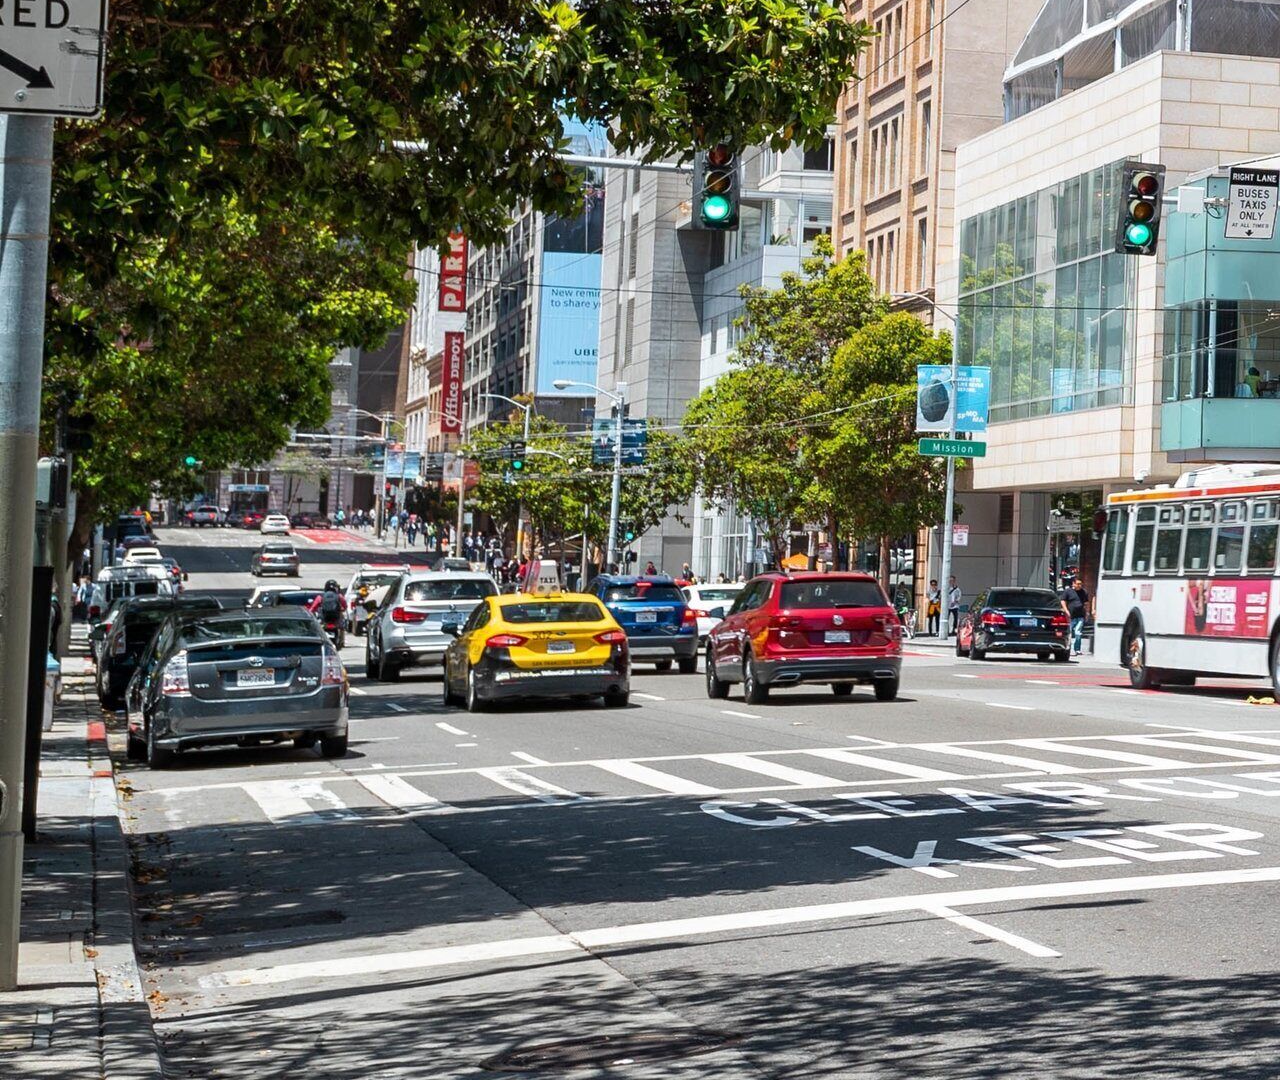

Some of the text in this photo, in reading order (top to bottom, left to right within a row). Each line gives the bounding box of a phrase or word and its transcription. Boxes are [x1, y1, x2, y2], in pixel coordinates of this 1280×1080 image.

[1232, 173, 1277, 183] RIGHT LANE
[1237, 188, 1270, 199] BUSES
[1240, 200, 1267, 210] TAXIS
[1239, 211, 1265, 220] ONLY
[551, 288, 573, 298] New
[550, 299, 562, 308] to
[563, 299, 591, 308] share
[574, 348, 599, 358] UBE
[445, 336, 461, 428] Office DEPOT
[932, 443, 974, 454] Mission
[700, 781, 1163, 828] CLEAR
[850, 822, 1264, 879] KEEP
